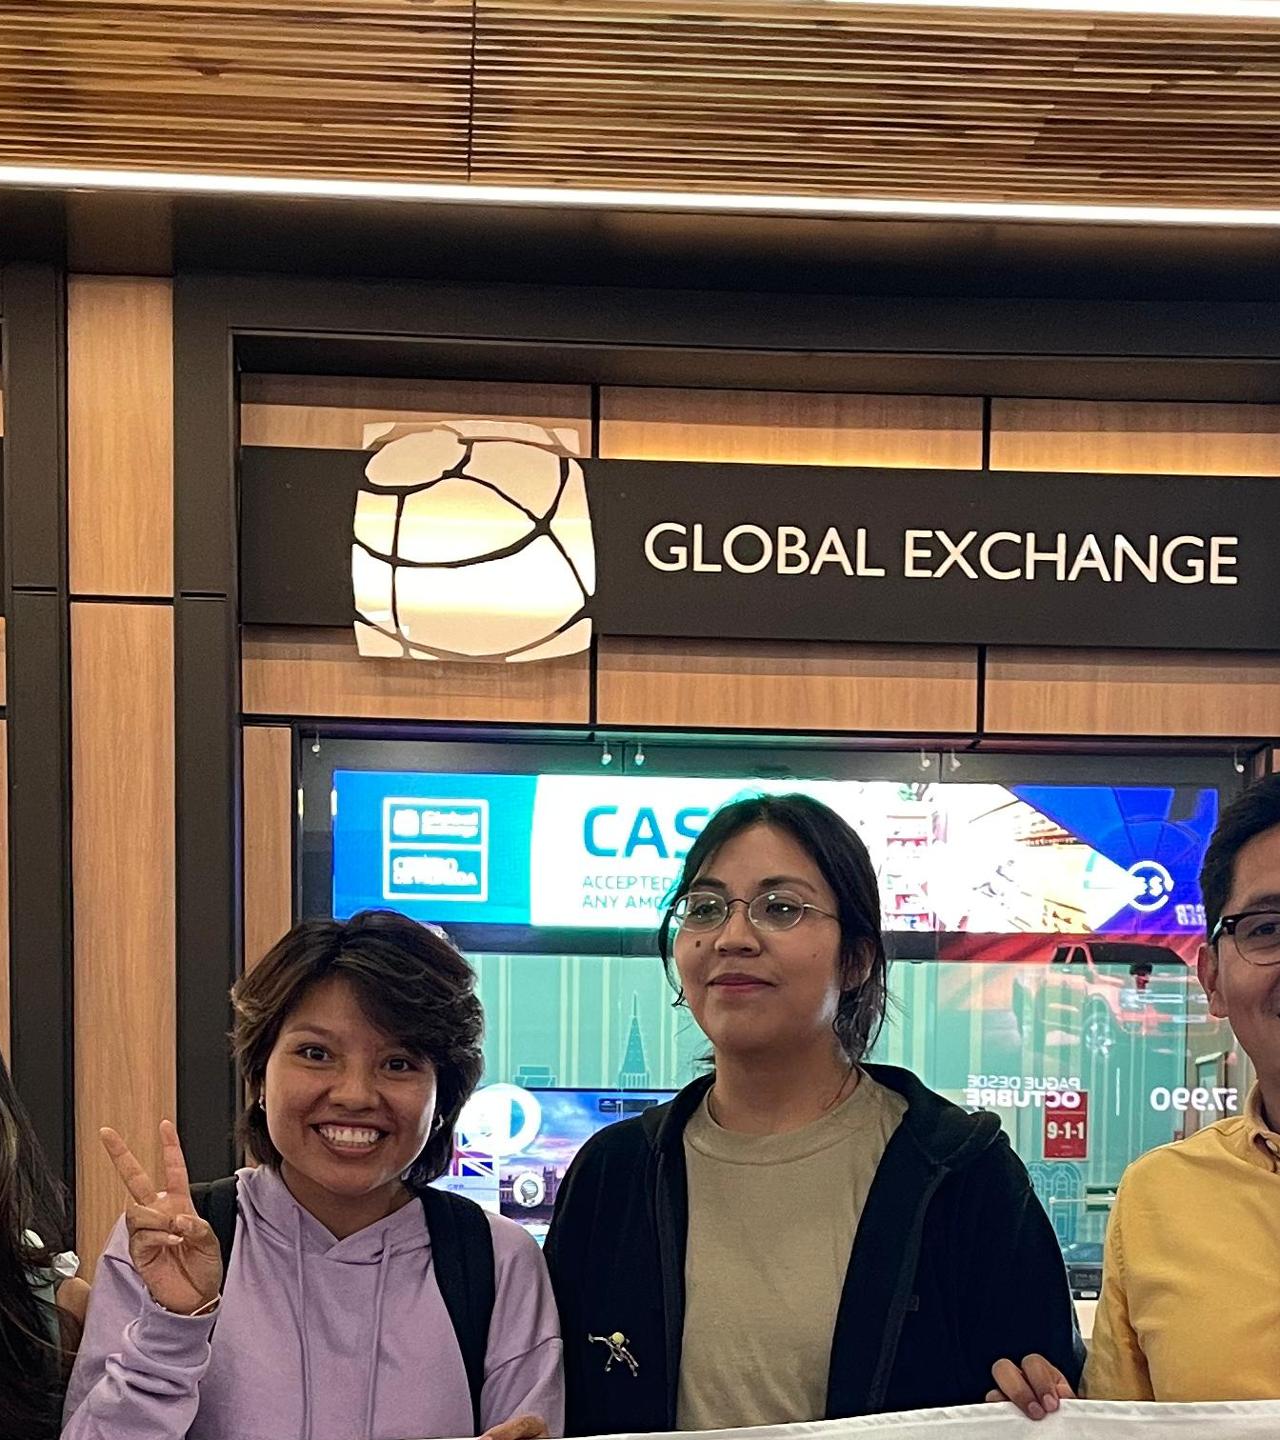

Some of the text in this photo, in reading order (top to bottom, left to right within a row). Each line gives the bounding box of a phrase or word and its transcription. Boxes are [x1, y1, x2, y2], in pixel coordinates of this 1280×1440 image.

[644, 523, 1238, 585] GLOBAL EXCHANGE
[584, 805, 710, 858] CAS
[582, 875, 673, 890] ACCEPTED
[582, 895, 663, 909] ANY AMO
[1047, 1121, 1084, 1139] 9-1-1
